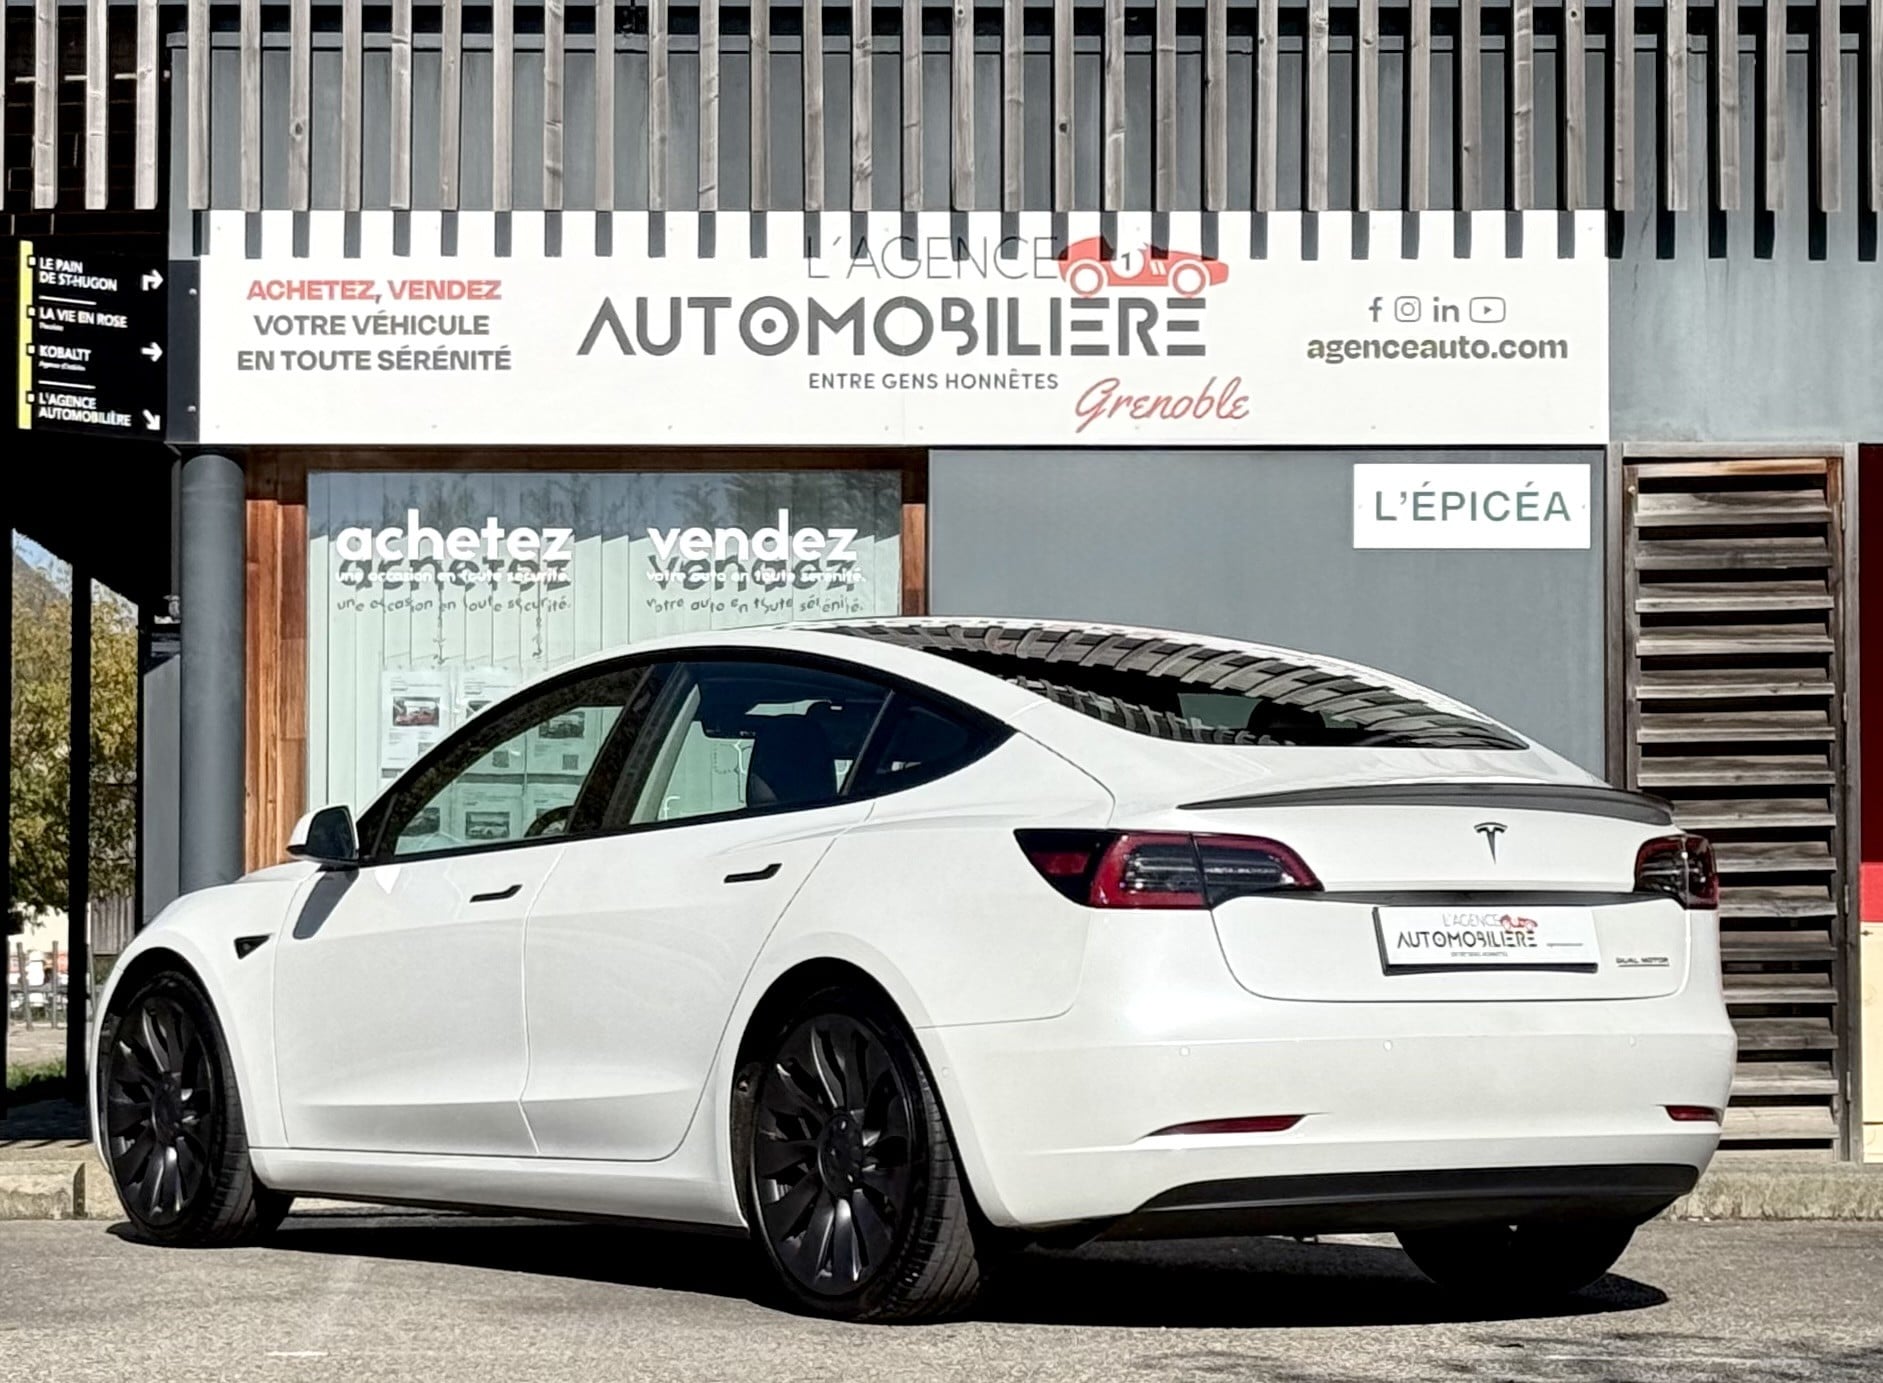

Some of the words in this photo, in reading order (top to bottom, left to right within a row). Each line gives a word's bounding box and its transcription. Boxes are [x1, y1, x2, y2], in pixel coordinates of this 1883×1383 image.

[39, 256, 54, 271] LE
[55, 258, 83, 274] PAIN
[807, 235, 1058, 279] L'AGENCE
[39, 270, 57, 285] DE
[58, 273, 118, 292] ST-HUGON
[246, 279, 382, 304] ACHETEZ,
[387, 279, 502, 301] VENDEZ
[39, 306, 56, 321] LA
[56, 308, 77, 323] VIE
[77, 310, 95, 325] EN
[96, 312, 128, 329] ROSE
[253, 315, 346, 336] VOTRE
[352, 310, 490, 336] VÉHICULE
[237, 350, 276, 371] EN
[280, 350, 371, 371] TOUTE
[377, 345, 512, 371] SÉRÉNITÉ
[1306, 335, 1569, 364] agenceauto.com
[808, 373, 876, 390] ENTRE
[881, 373, 938, 390] GENS
[946, 368, 1059, 390] HONNÊTES
[39, 392, 97, 409] L'AGENCE
[1074, 375, 1250, 434] Grenoble
[1374, 481, 1572, 522] L'ÉPICÉA
[335, 508, 573, 561] achetez
[646, 508, 858, 561] vendez
